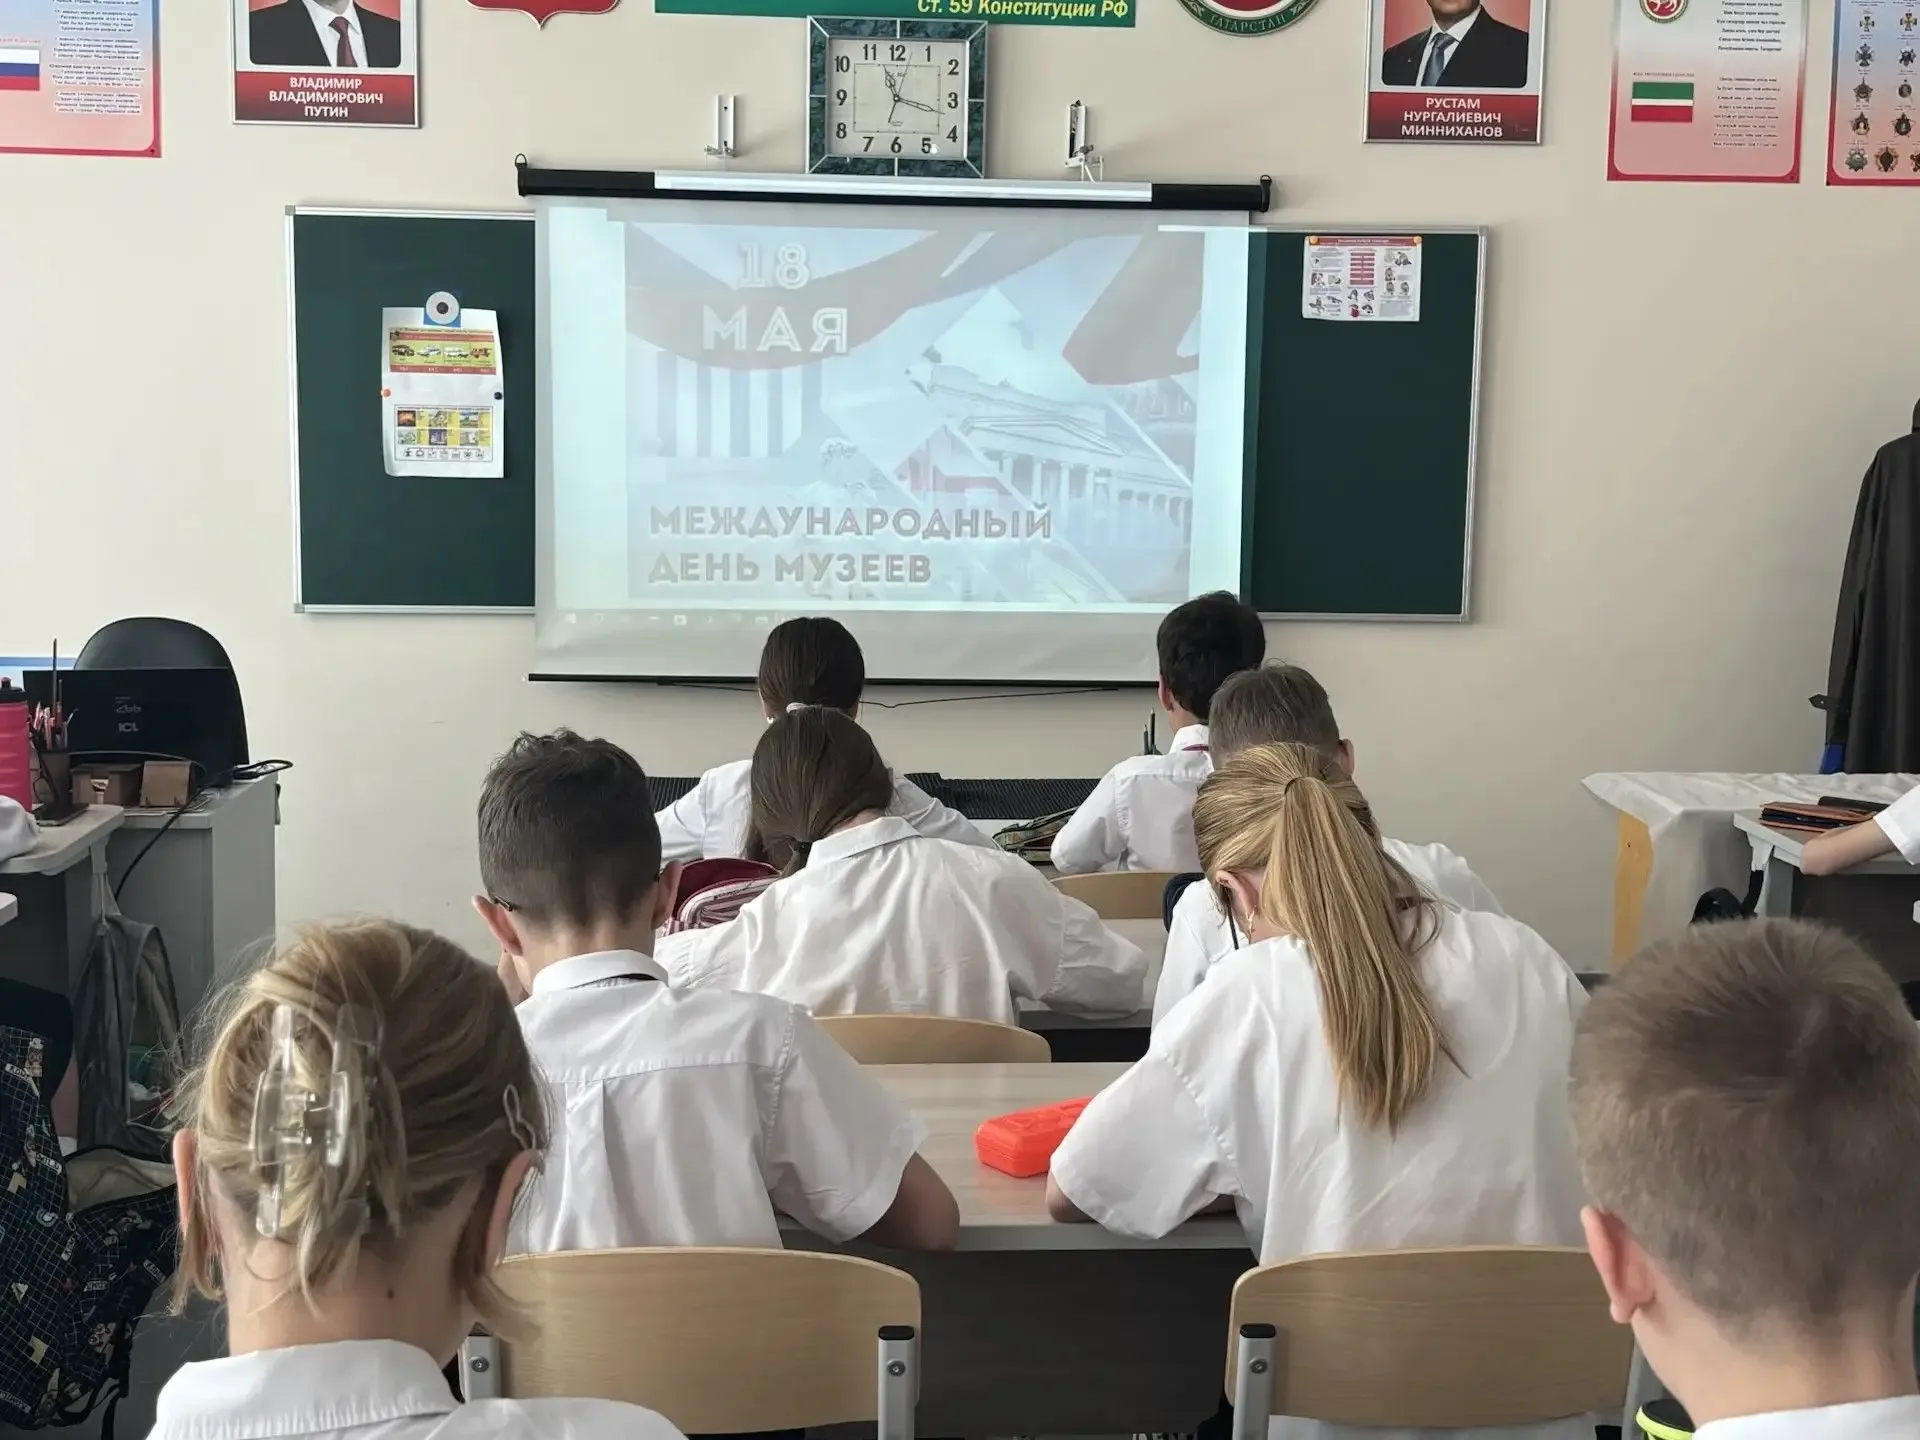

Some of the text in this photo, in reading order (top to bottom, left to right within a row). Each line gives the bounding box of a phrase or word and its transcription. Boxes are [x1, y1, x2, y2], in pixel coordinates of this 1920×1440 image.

[917, 0, 1129, 20] Ст. 59 Конституции РФ
[1210, 14, 1286, 31] ТАТАРСТАН
[863, 44, 877, 61] 11
[889, 45, 906, 62] 12
[925, 46, 931, 62] 1
[835, 55, 850, 73] 10
[948, 59, 960, 76] 2
[289, 77, 363, 90] ВЛАДИМИР
[269, 91, 384, 104] ВЛАДИМИРОВИЧ
[836, 89, 847, 106] 9
[948, 92, 959, 109] 3
[1425, 97, 1481, 109] РУСТАМ
[304, 105, 349, 117] ПУТИН
[1403, 111, 1502, 123] НУРГАЛИЕВИЧ
[836, 122, 847, 139] 8
[946, 126, 958, 143] 4
[1401, 124, 1503, 138] МИННИХАНОВ
[863, 137, 874, 152] 7
[891, 136, 902, 153] 6
[921, 137, 932, 154] 5
[738, 242, 810, 290] 18
[702, 304, 849, 354] МАЯ
[649, 502, 1052, 540] МЕЖДУНАРОДНЫЙ
[648, 552, 931, 584] ДЕНЬ МУЗЕЕВ
